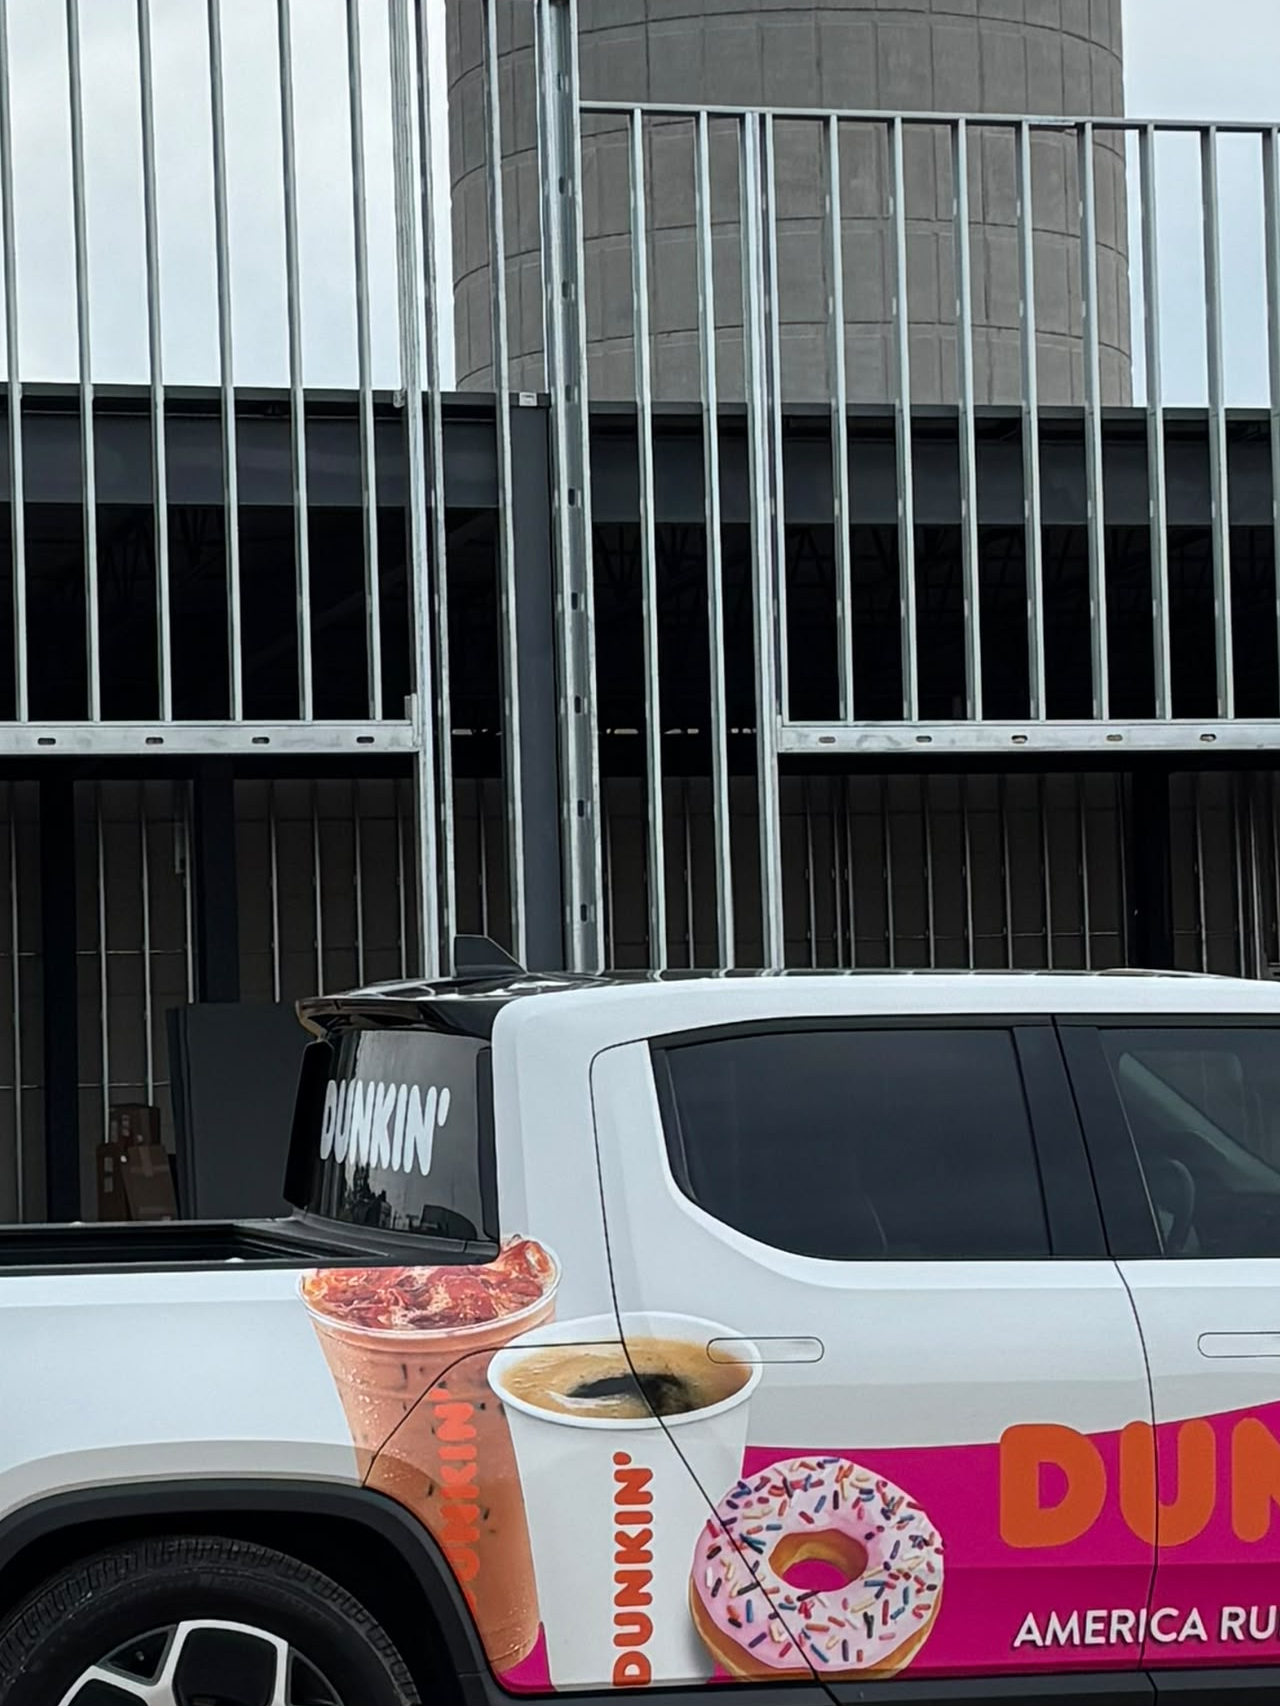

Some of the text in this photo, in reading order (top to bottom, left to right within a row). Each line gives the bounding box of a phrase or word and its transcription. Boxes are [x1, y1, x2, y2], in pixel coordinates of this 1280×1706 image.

[320, 1079, 451, 1176] DUNKIN'
[428, 1388, 481, 1615] UNKIN'
[612, 1451, 654, 1687] DUNKIN'
[1013, 1607, 1208, 1648] AMERICA
